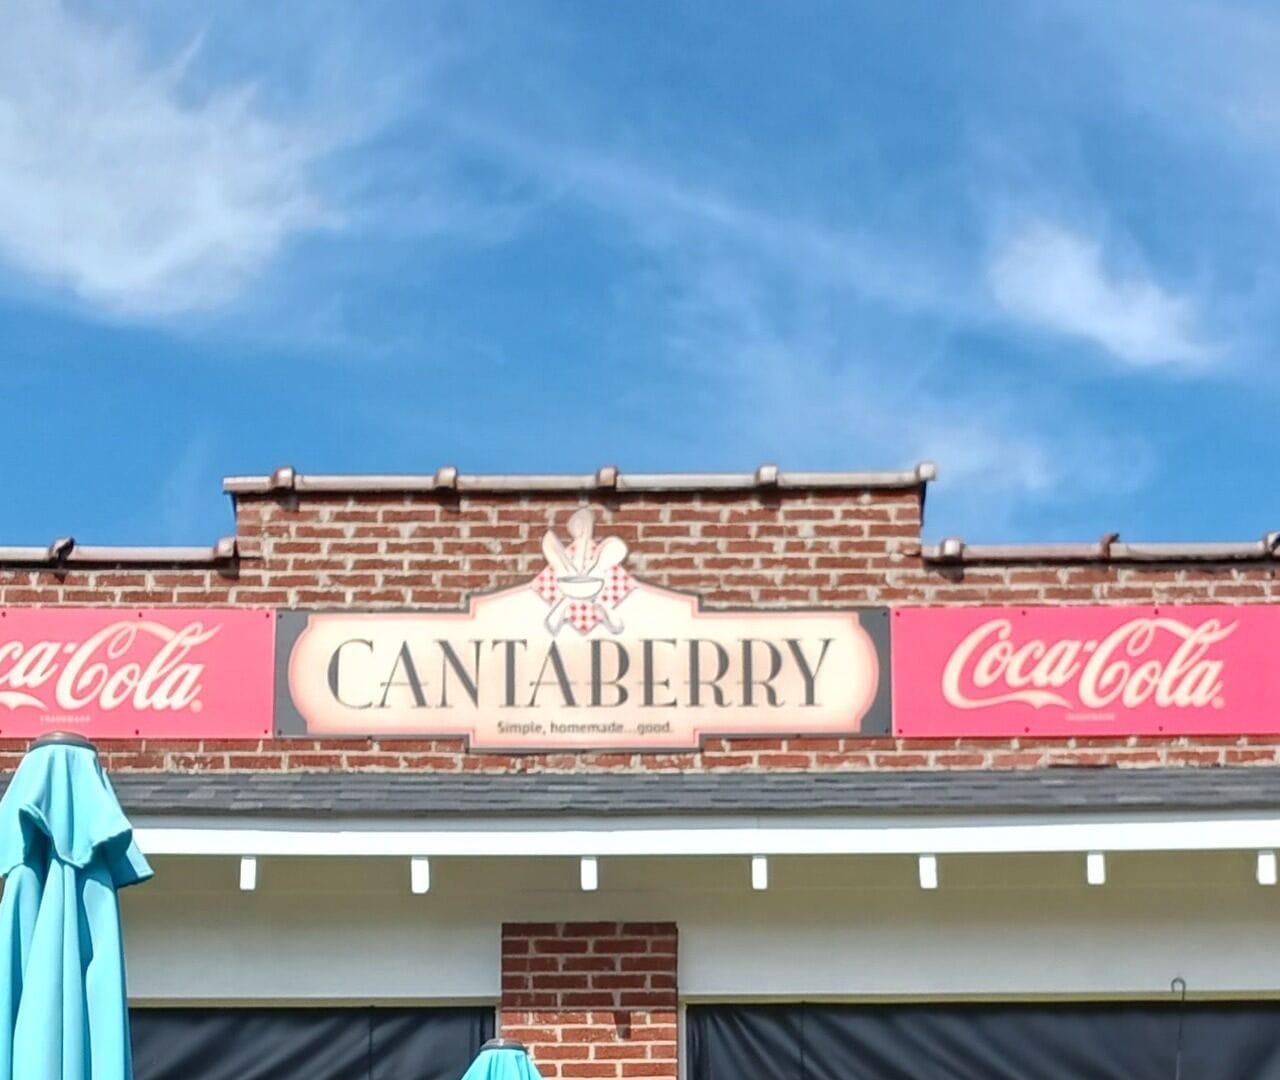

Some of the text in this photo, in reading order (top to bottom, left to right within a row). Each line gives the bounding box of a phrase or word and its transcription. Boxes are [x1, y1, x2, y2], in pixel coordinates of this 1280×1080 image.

[326, 637, 835, 711] CANTABERRY
[941, 617, 1239, 711] Coca-Cola
[497, 720, 548, 736] Simple,
